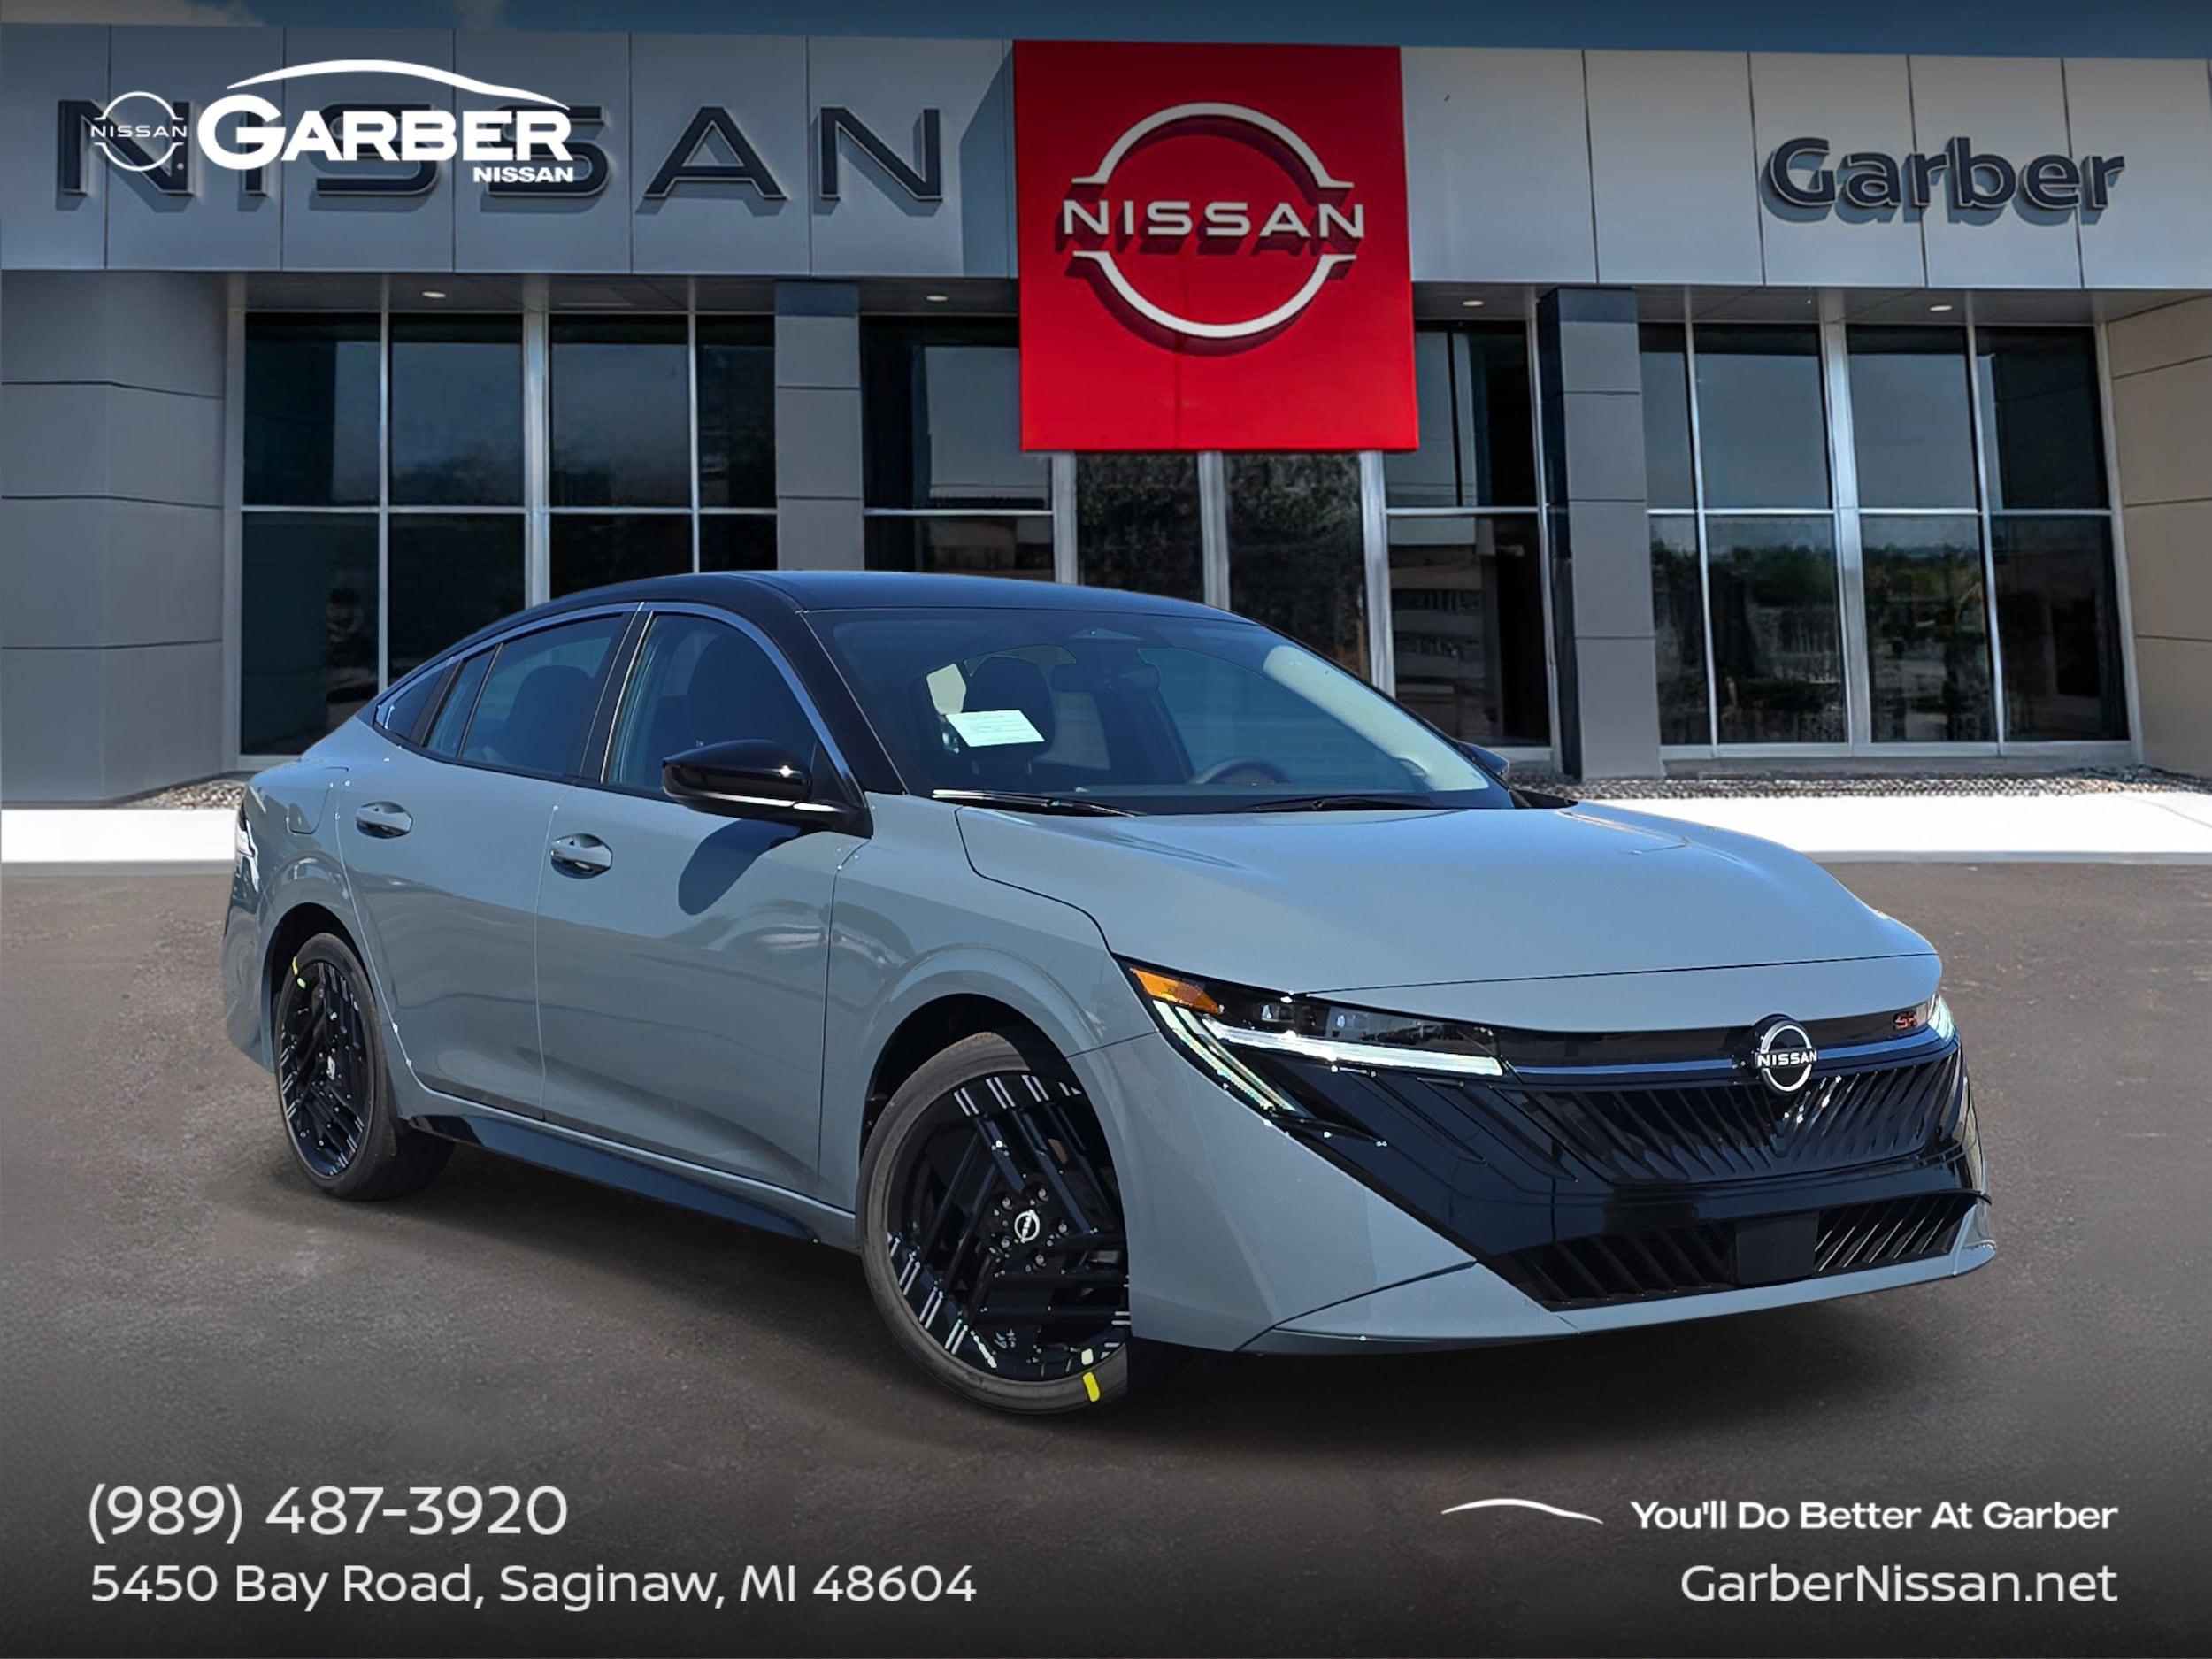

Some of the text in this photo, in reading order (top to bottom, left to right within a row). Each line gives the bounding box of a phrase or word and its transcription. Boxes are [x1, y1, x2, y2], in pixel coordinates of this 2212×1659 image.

[1770, 136, 2125, 209] Garber
[1063, 198, 1366, 240] NISSAN
[1757, 1050, 1817, 1067] NISSAN
